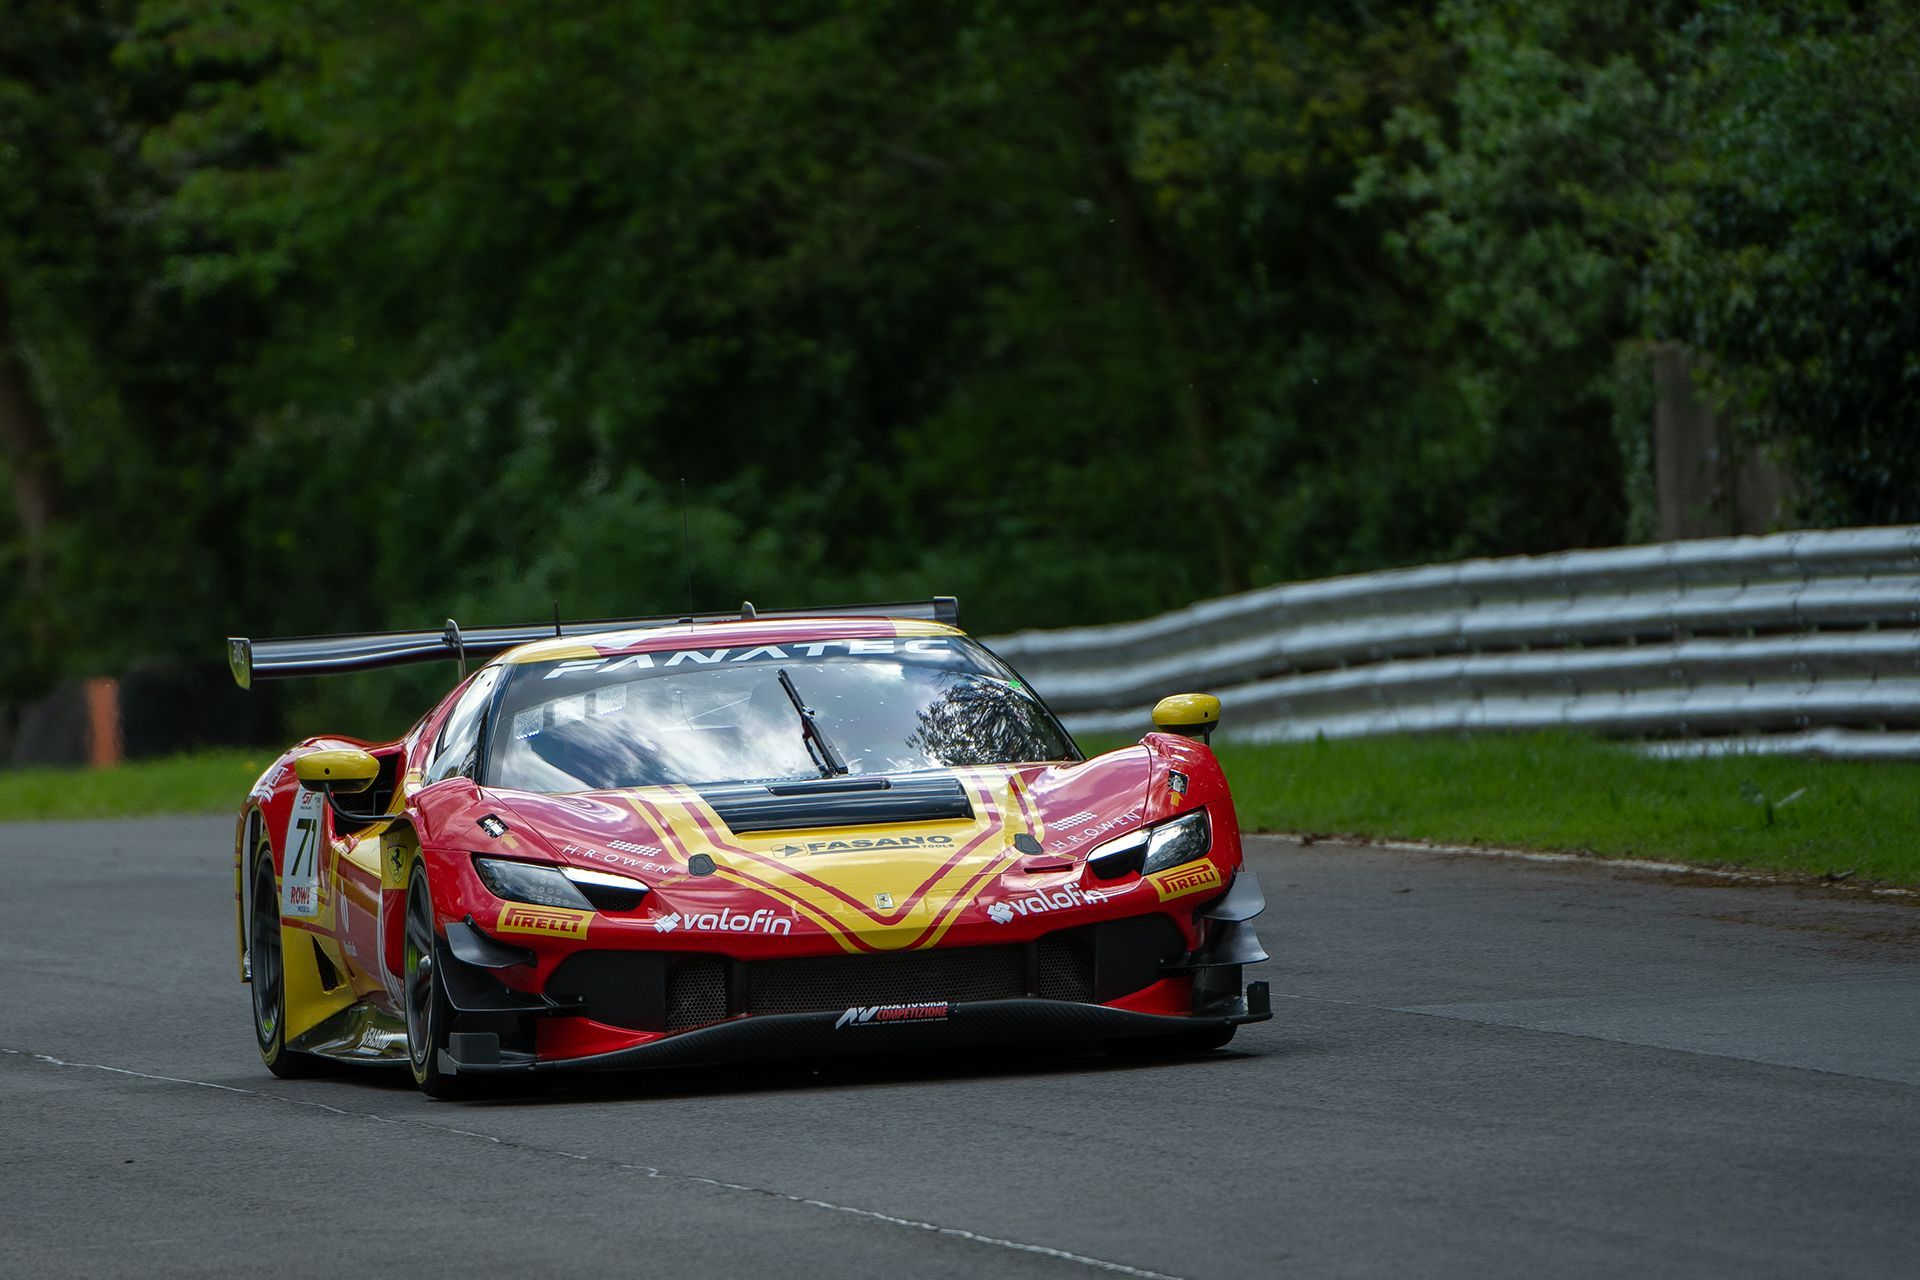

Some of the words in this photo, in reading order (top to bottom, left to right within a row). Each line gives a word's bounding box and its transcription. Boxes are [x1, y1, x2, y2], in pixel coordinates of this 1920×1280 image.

[543, 640, 951, 680] FANATEC
[291, 818, 317, 877] 71
[807, 835, 952, 851] FASANO
[921, 839, 954, 848] TOOLS
[1157, 864, 1216, 895] PIRELLI
[503, 907, 584, 933] PIRELLI
[684, 907, 792, 935] valofin
[876, 1006, 948, 1020] COMPETIZIONE
